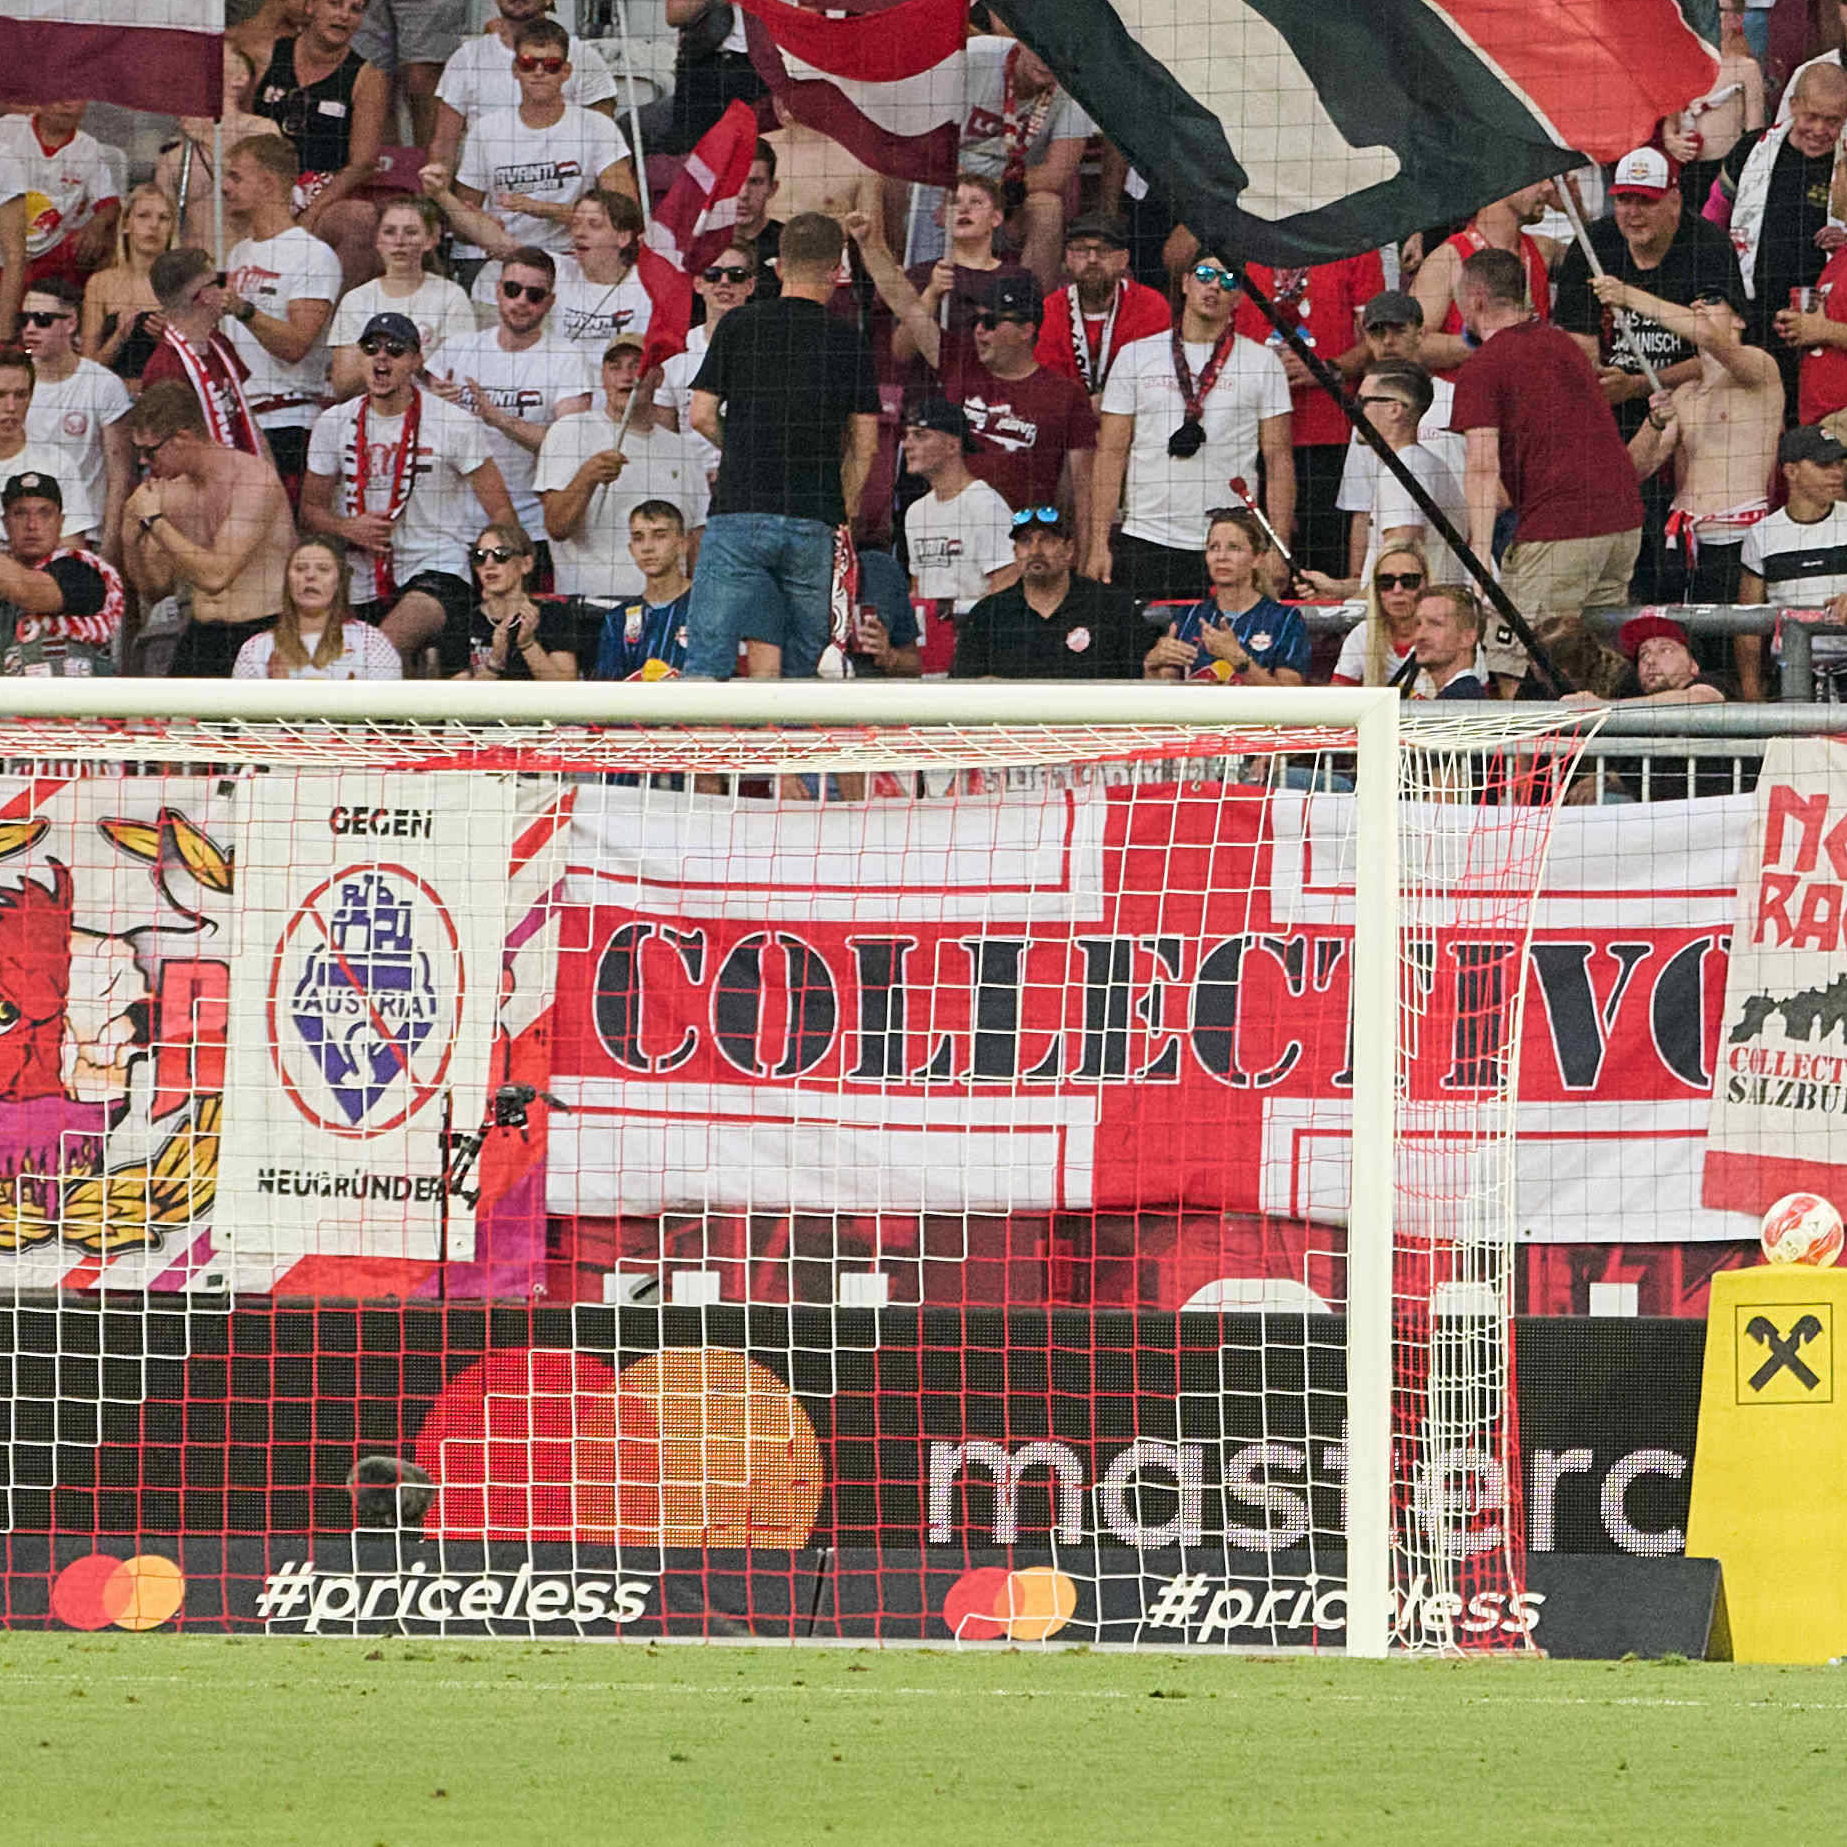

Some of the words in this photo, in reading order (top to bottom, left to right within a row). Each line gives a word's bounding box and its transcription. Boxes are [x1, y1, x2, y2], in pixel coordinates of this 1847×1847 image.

[329, 805, 433, 839] GEGEN
[256, 1561, 654, 1625] #priceless
[1148, 1572, 1544, 1647] #pricless
